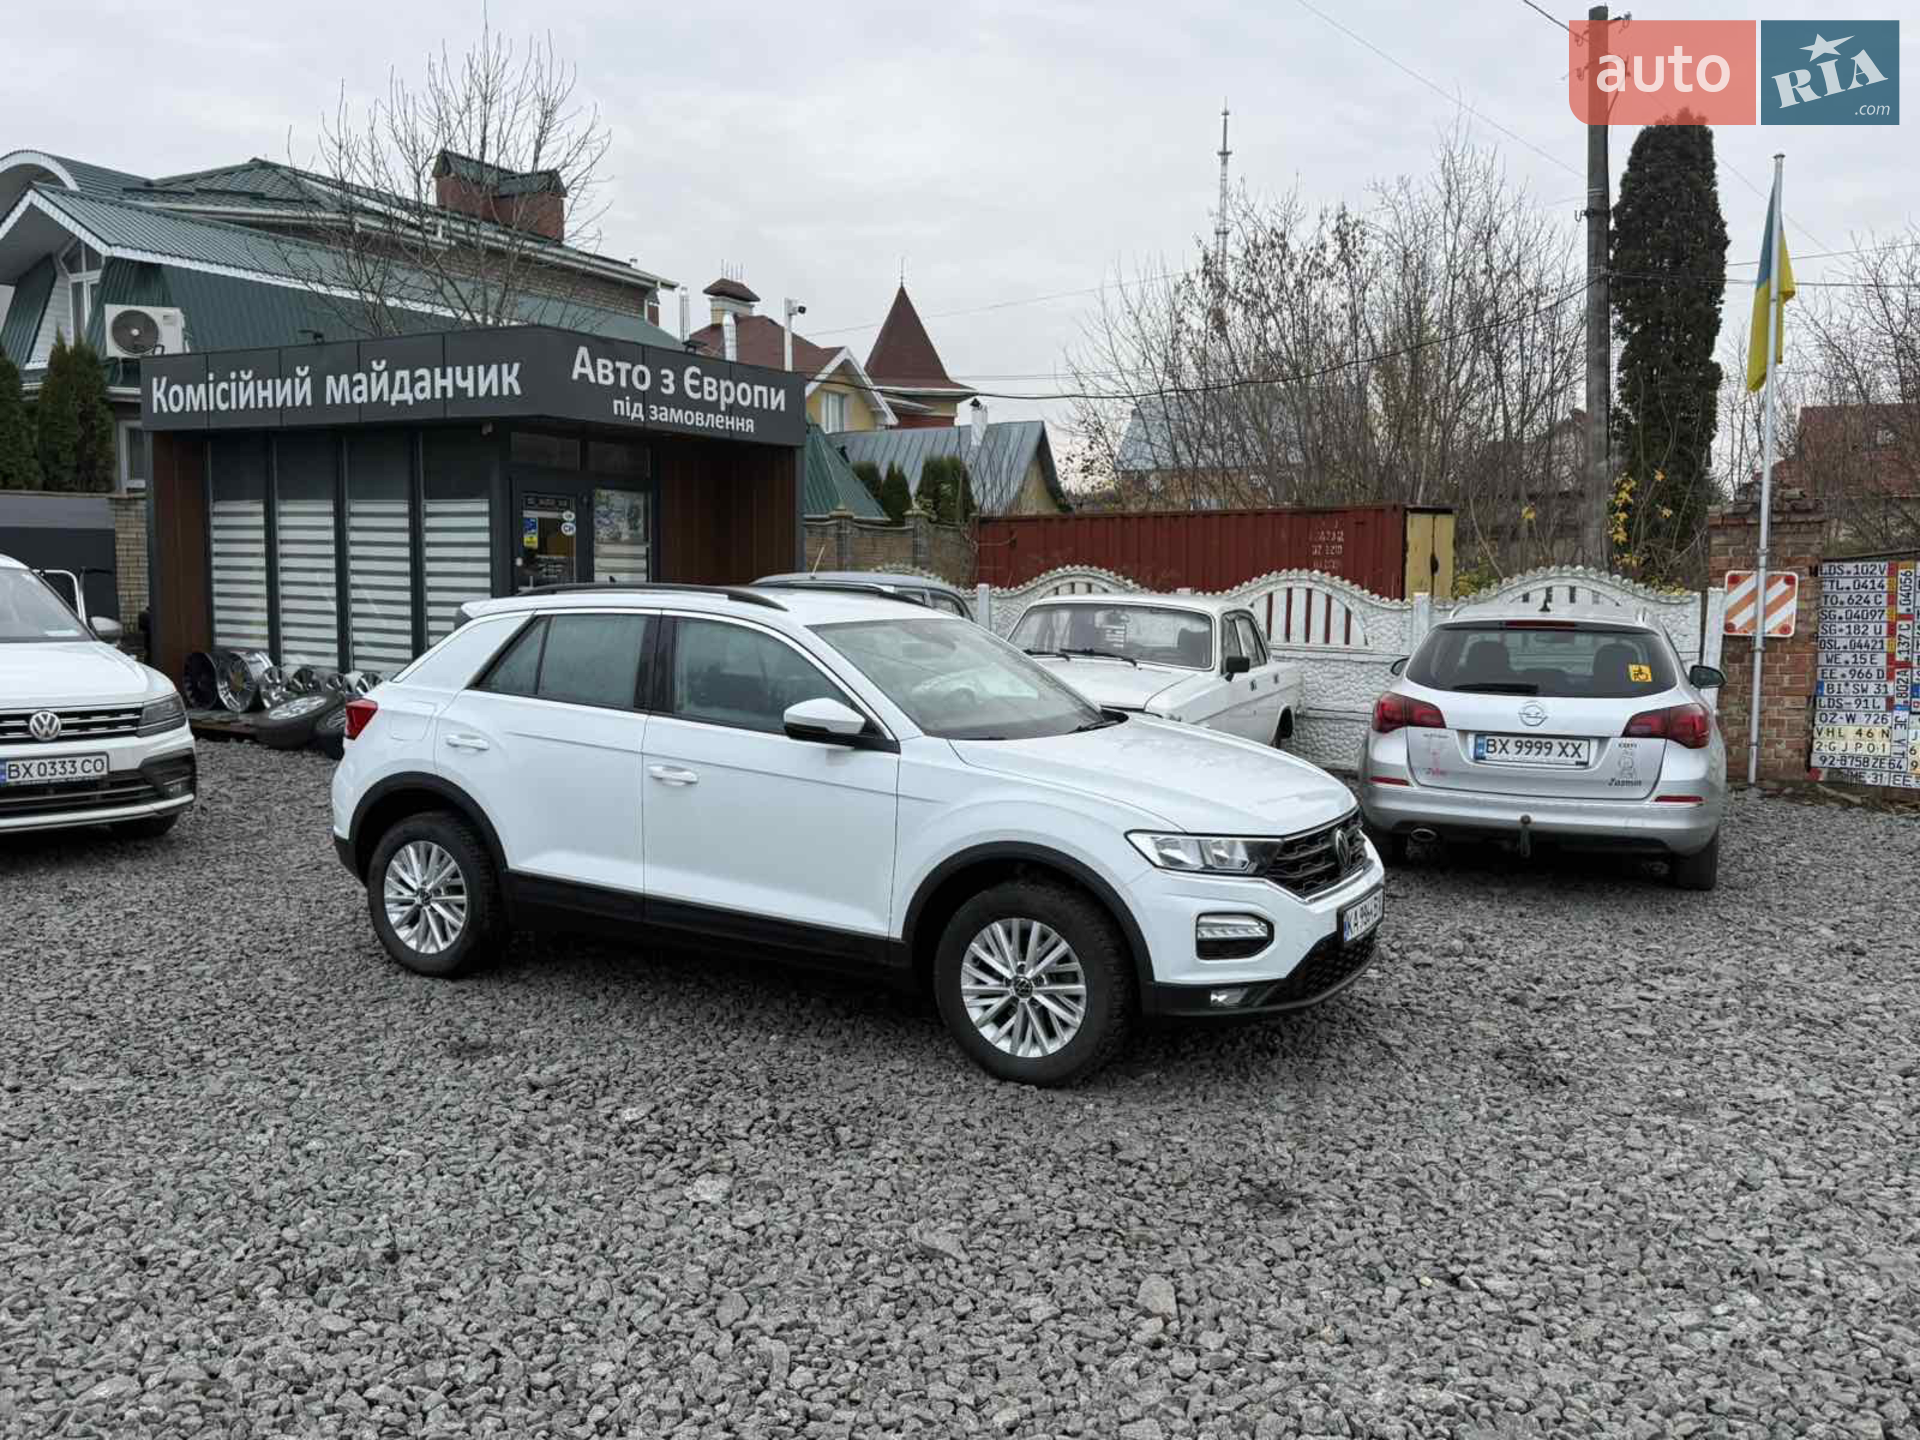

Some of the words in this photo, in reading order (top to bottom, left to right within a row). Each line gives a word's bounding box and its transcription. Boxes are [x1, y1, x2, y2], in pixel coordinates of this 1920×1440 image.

[152, 365, 312, 414] Комісійний
[325, 359, 522, 406] майданчик
[571, 345, 651, 391] Авто
[660, 368, 676, 395] з
[683, 365, 786, 412] Європи
[613, 396, 645, 422] під
[649, 404, 755, 433] замовлення
[1486, 738, 1510, 755] BX
[1514, 739, 1554, 757] 9999
[1557, 741, 1583, 759] XX
[8, 762, 34, 780] BX
[37, 760, 78, 777] 0333
[80, 758, 105, 774] CO
